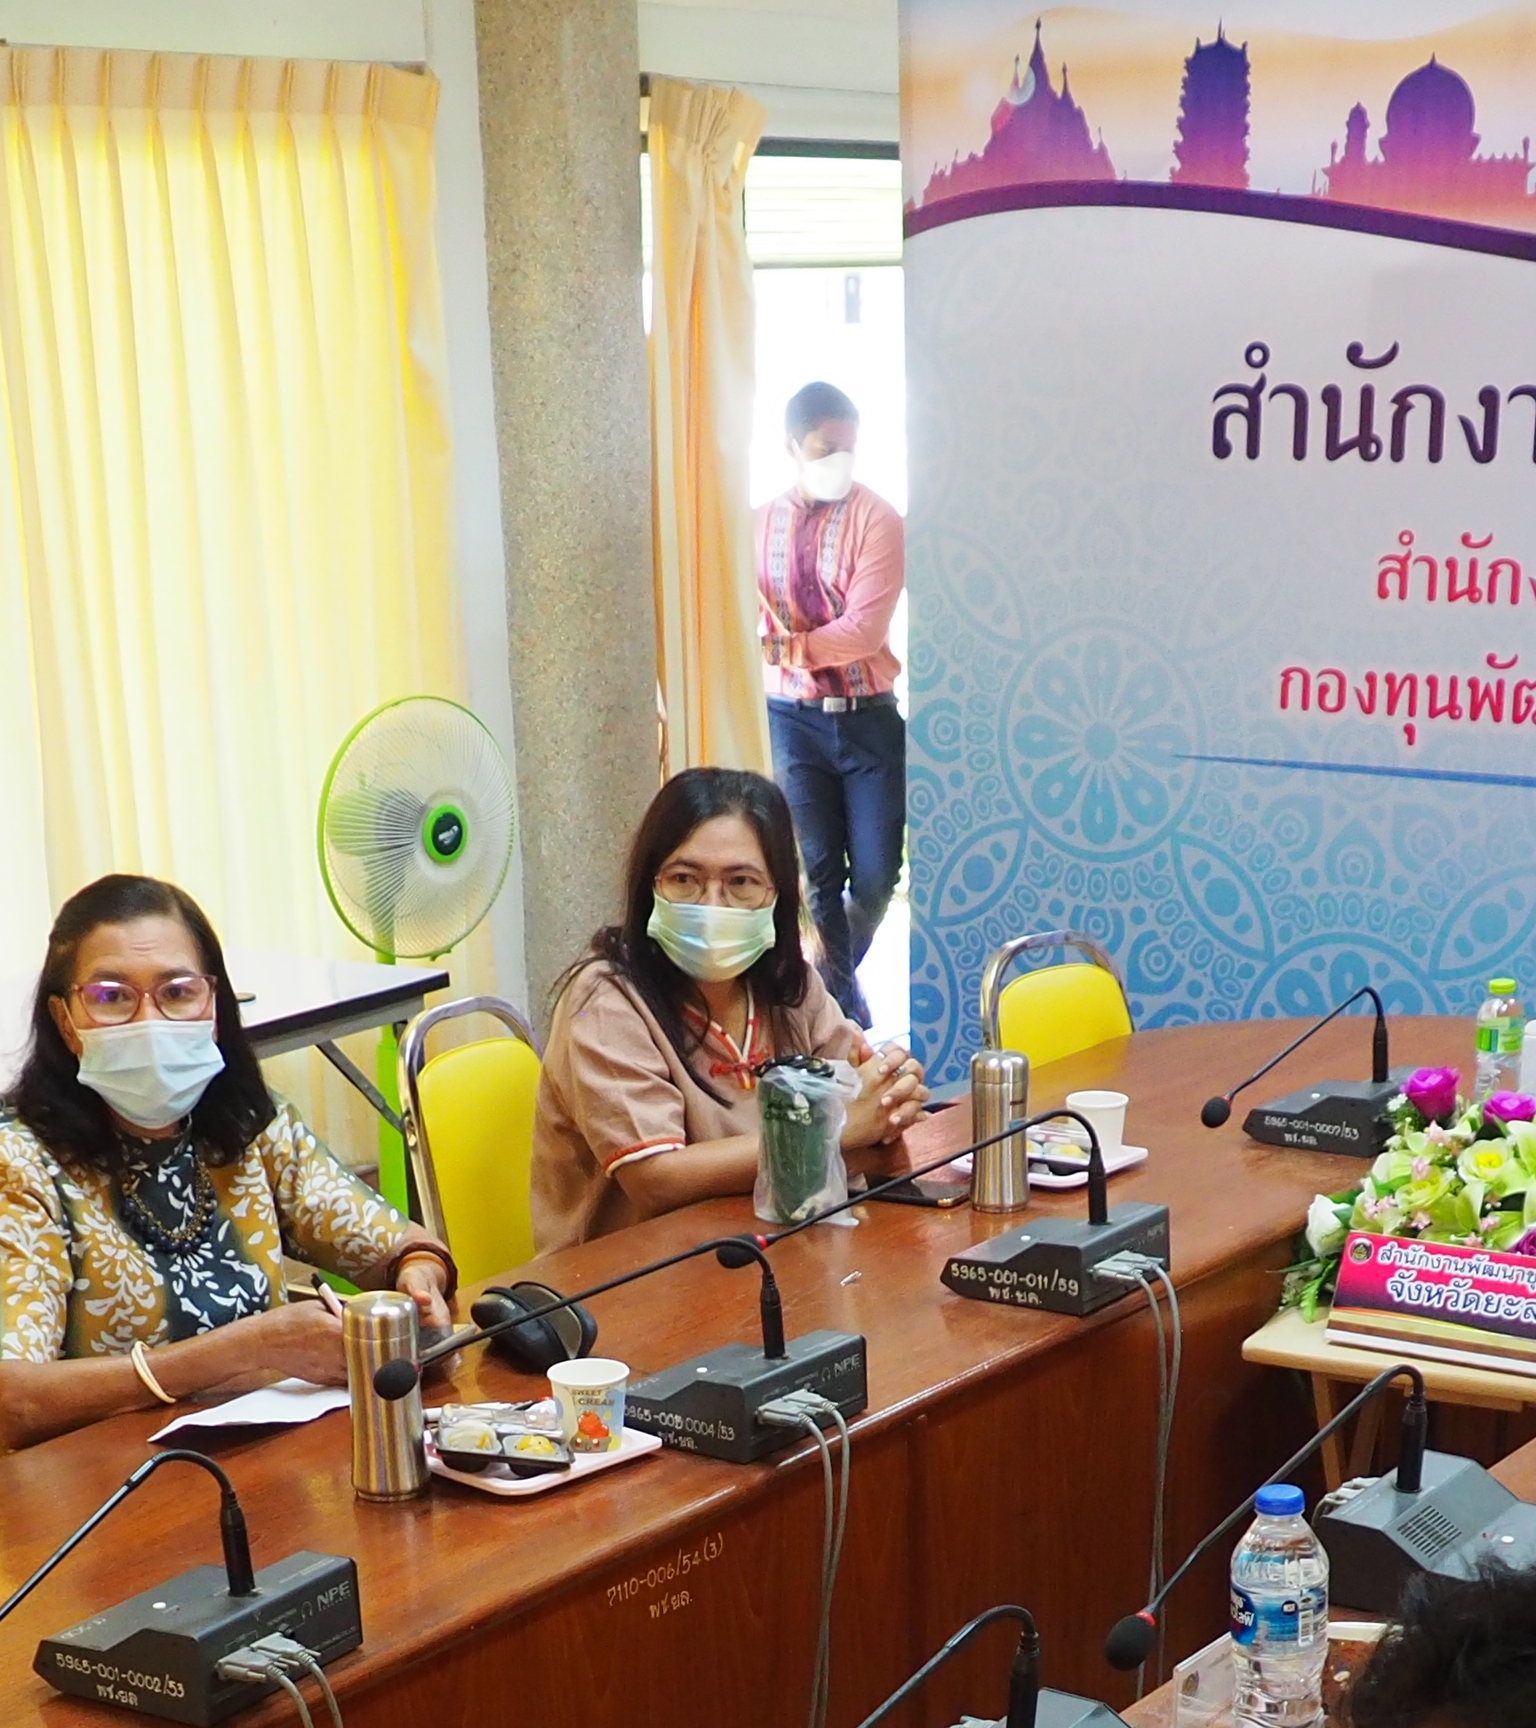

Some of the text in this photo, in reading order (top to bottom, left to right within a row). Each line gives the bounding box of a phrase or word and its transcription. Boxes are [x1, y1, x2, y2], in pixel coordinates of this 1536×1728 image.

[951, 1262, 1079, 1297] 5965-001-011/59
[833, 1353, 861, 1374] NPE
[317, 1580, 350, 1608] NPE
[55, 1652, 185, 1697] 5965-001-0002/53
